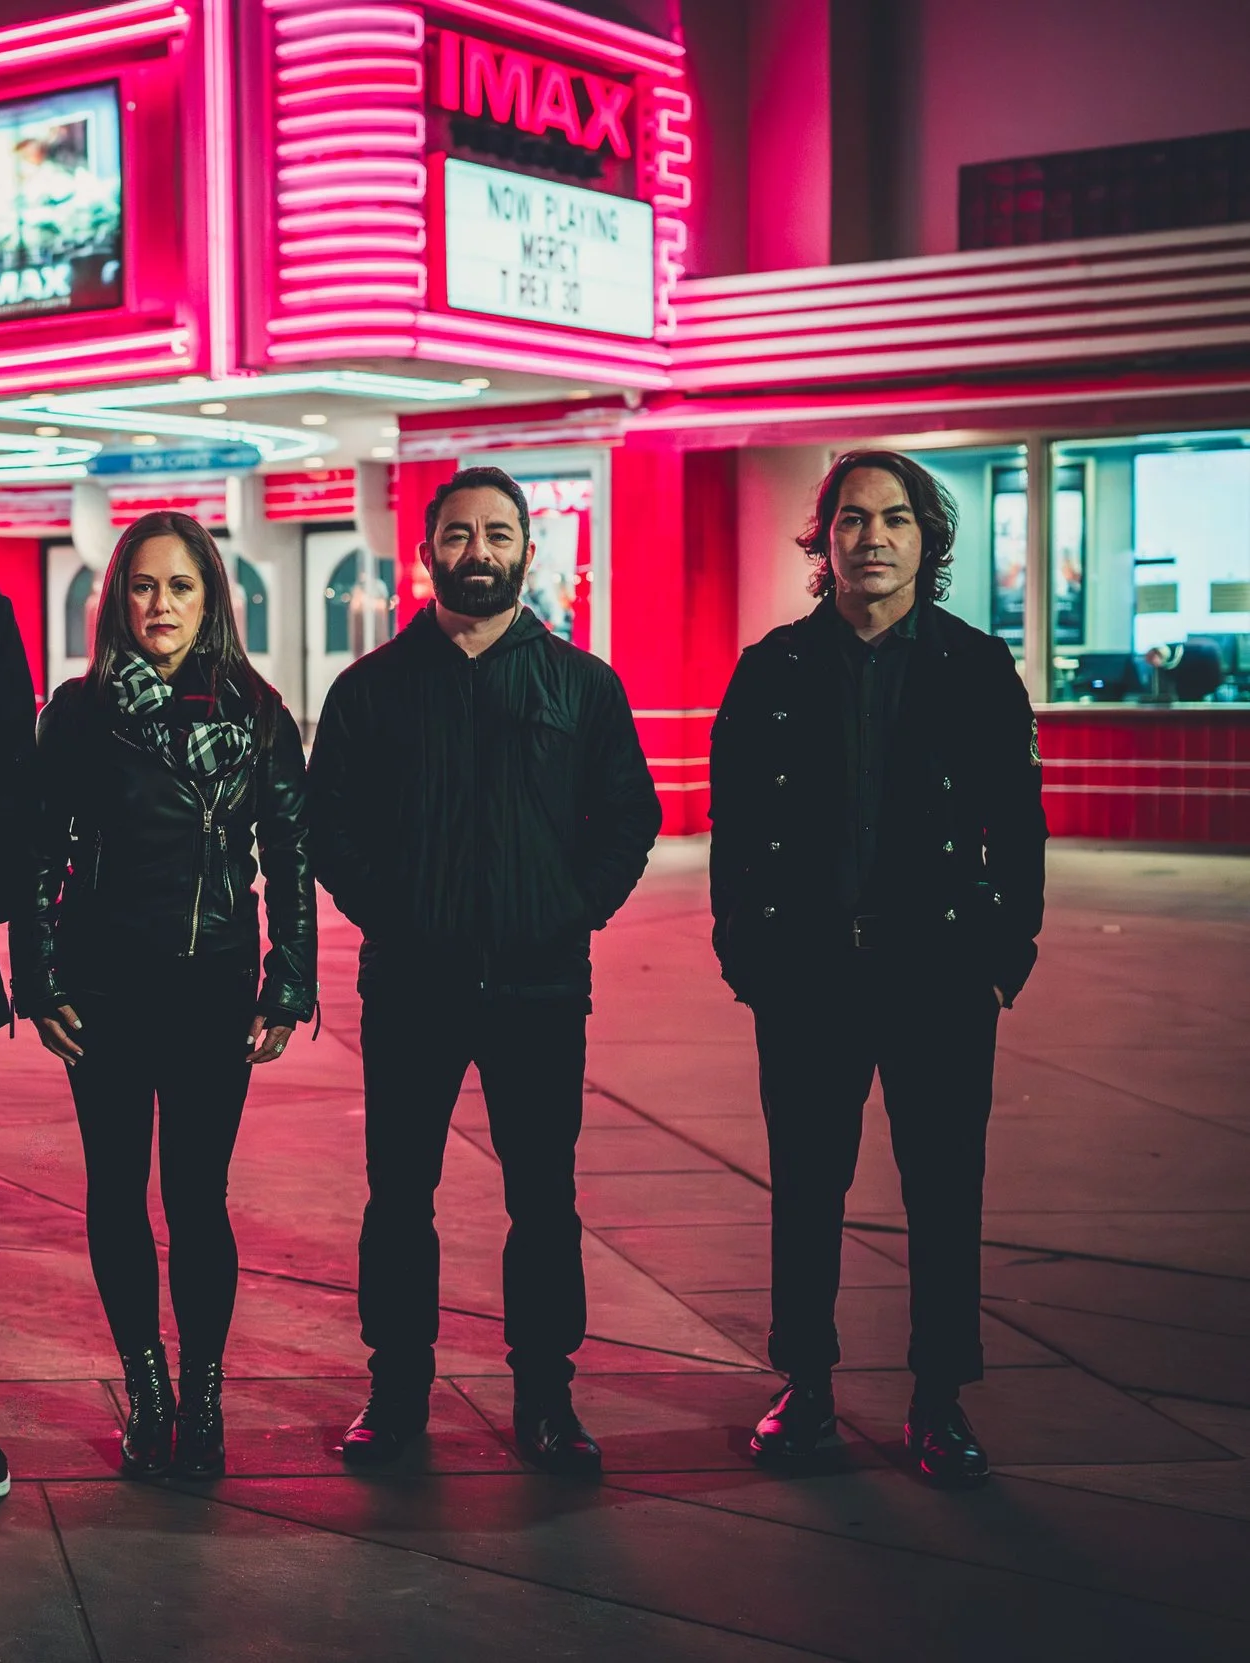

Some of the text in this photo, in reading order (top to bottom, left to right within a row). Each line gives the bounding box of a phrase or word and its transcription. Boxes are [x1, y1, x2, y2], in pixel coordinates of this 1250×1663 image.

[439, 30, 634, 160] IMAX
[487, 182, 619, 243] NOW PLAYING
[521, 230, 578, 275] MERCY
[518, 273, 550, 309] REX
